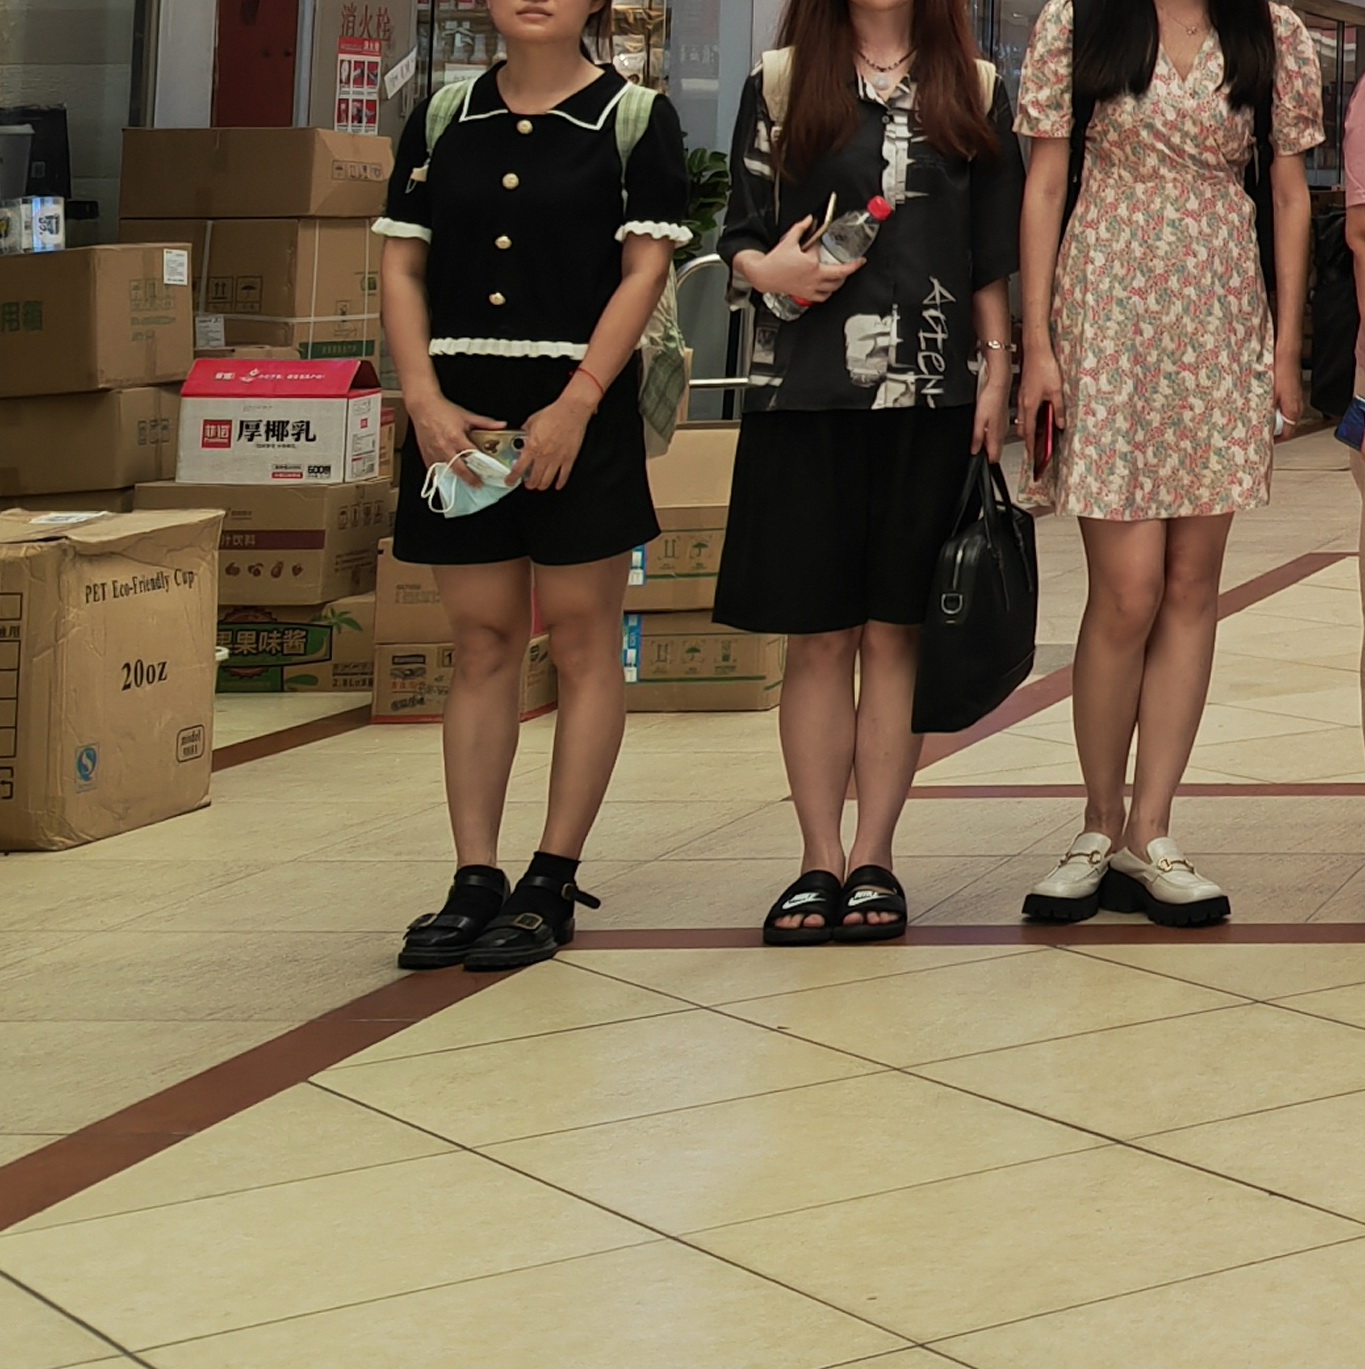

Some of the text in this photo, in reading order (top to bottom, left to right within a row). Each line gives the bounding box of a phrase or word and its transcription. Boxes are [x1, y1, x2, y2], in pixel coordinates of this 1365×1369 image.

[341, 1, 393, 42] 消火栓
[236, 419, 317, 443] 厚椰乳
[85, 567, 196, 605] PET Eco-Friendly Cup
[120, 658, 168, 692] 20oz
